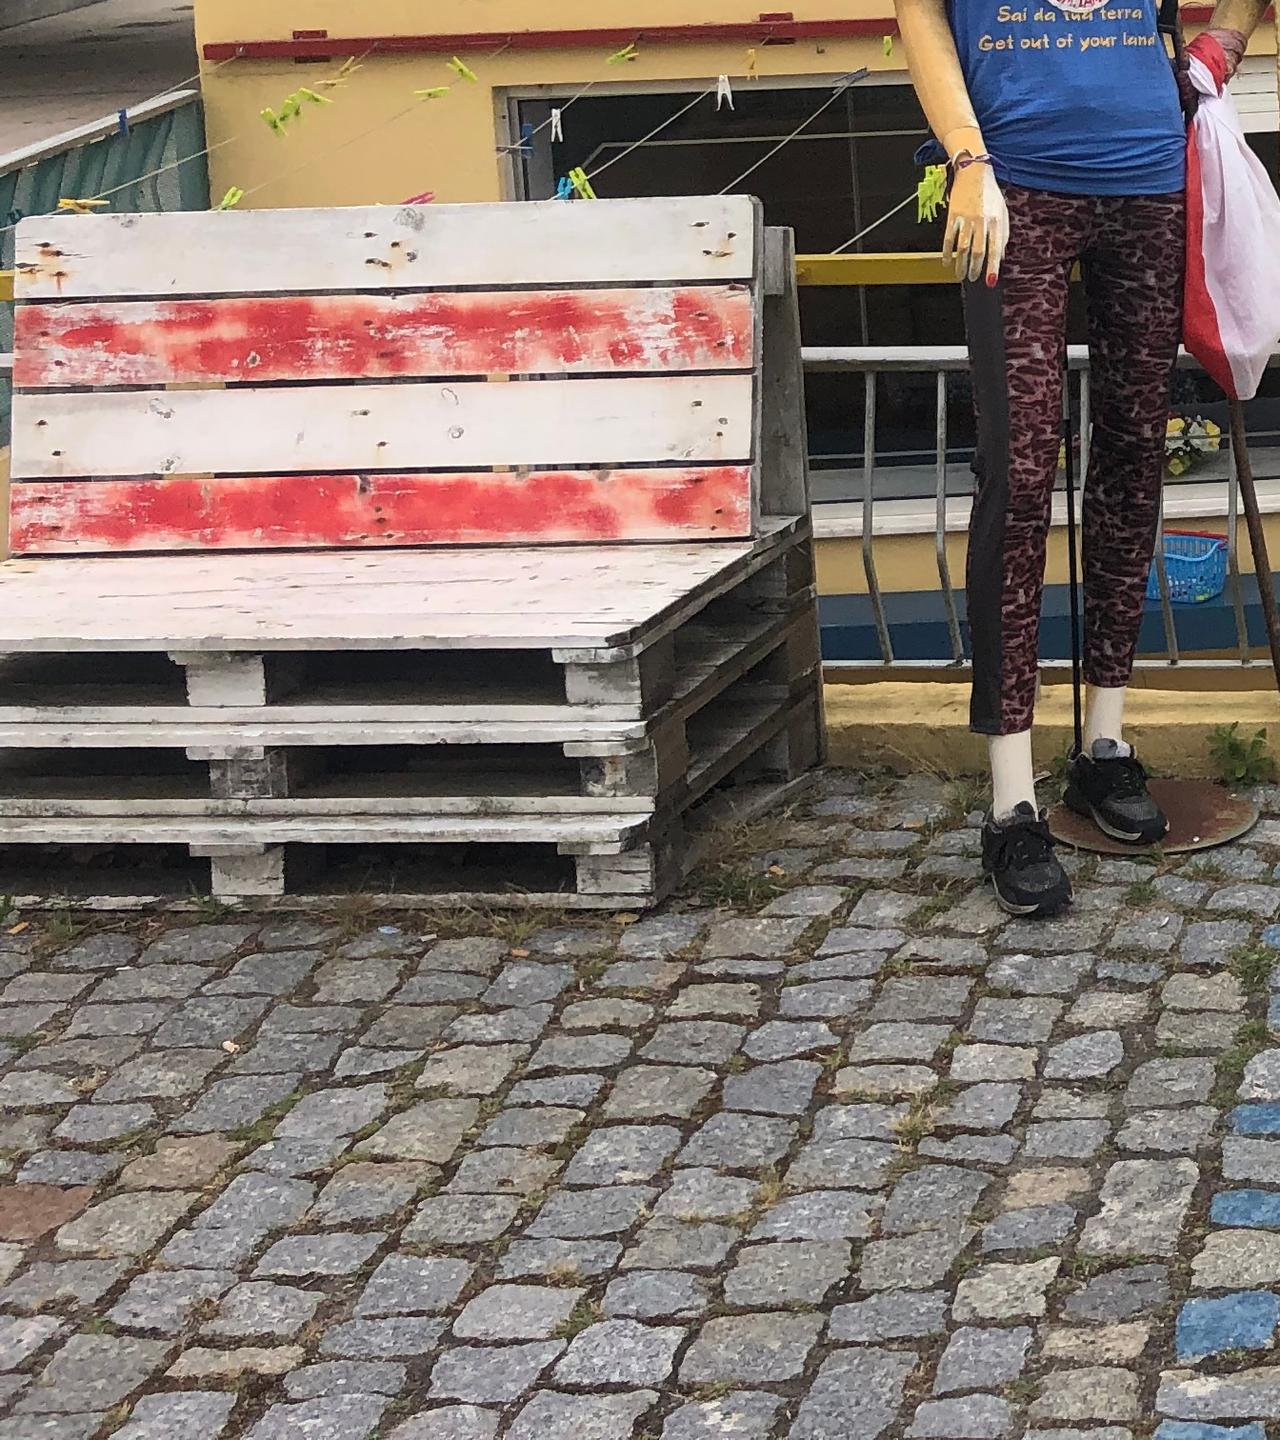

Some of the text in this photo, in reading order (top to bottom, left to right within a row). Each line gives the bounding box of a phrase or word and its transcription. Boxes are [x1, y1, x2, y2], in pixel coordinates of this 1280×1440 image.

[997, 6, 1028, 22] Sai
[1034, 7, 1056, 21] da
[1100, 7, 1143, 20] terra
[979, 35, 1015, 51] Get
[1020, 34, 1050, 49] out
[1056, 33, 1073, 48] of
[1080, 37, 1116, 51] your
